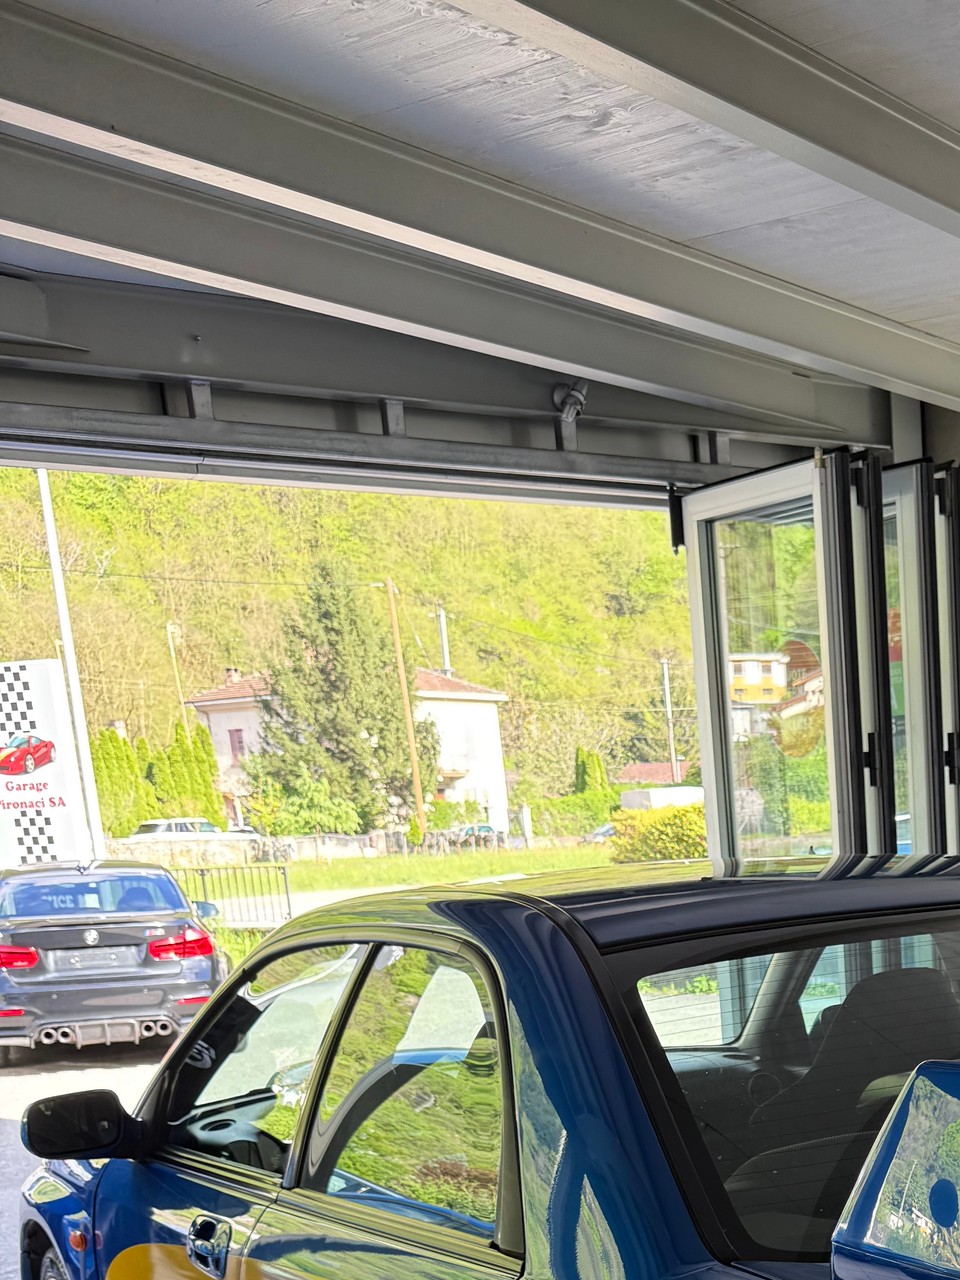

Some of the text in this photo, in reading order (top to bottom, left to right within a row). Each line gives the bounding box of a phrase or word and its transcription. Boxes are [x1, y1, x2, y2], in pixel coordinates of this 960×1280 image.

[5, 780, 49, 793] Garage
[0, 796, 67, 810] ironaci SA
